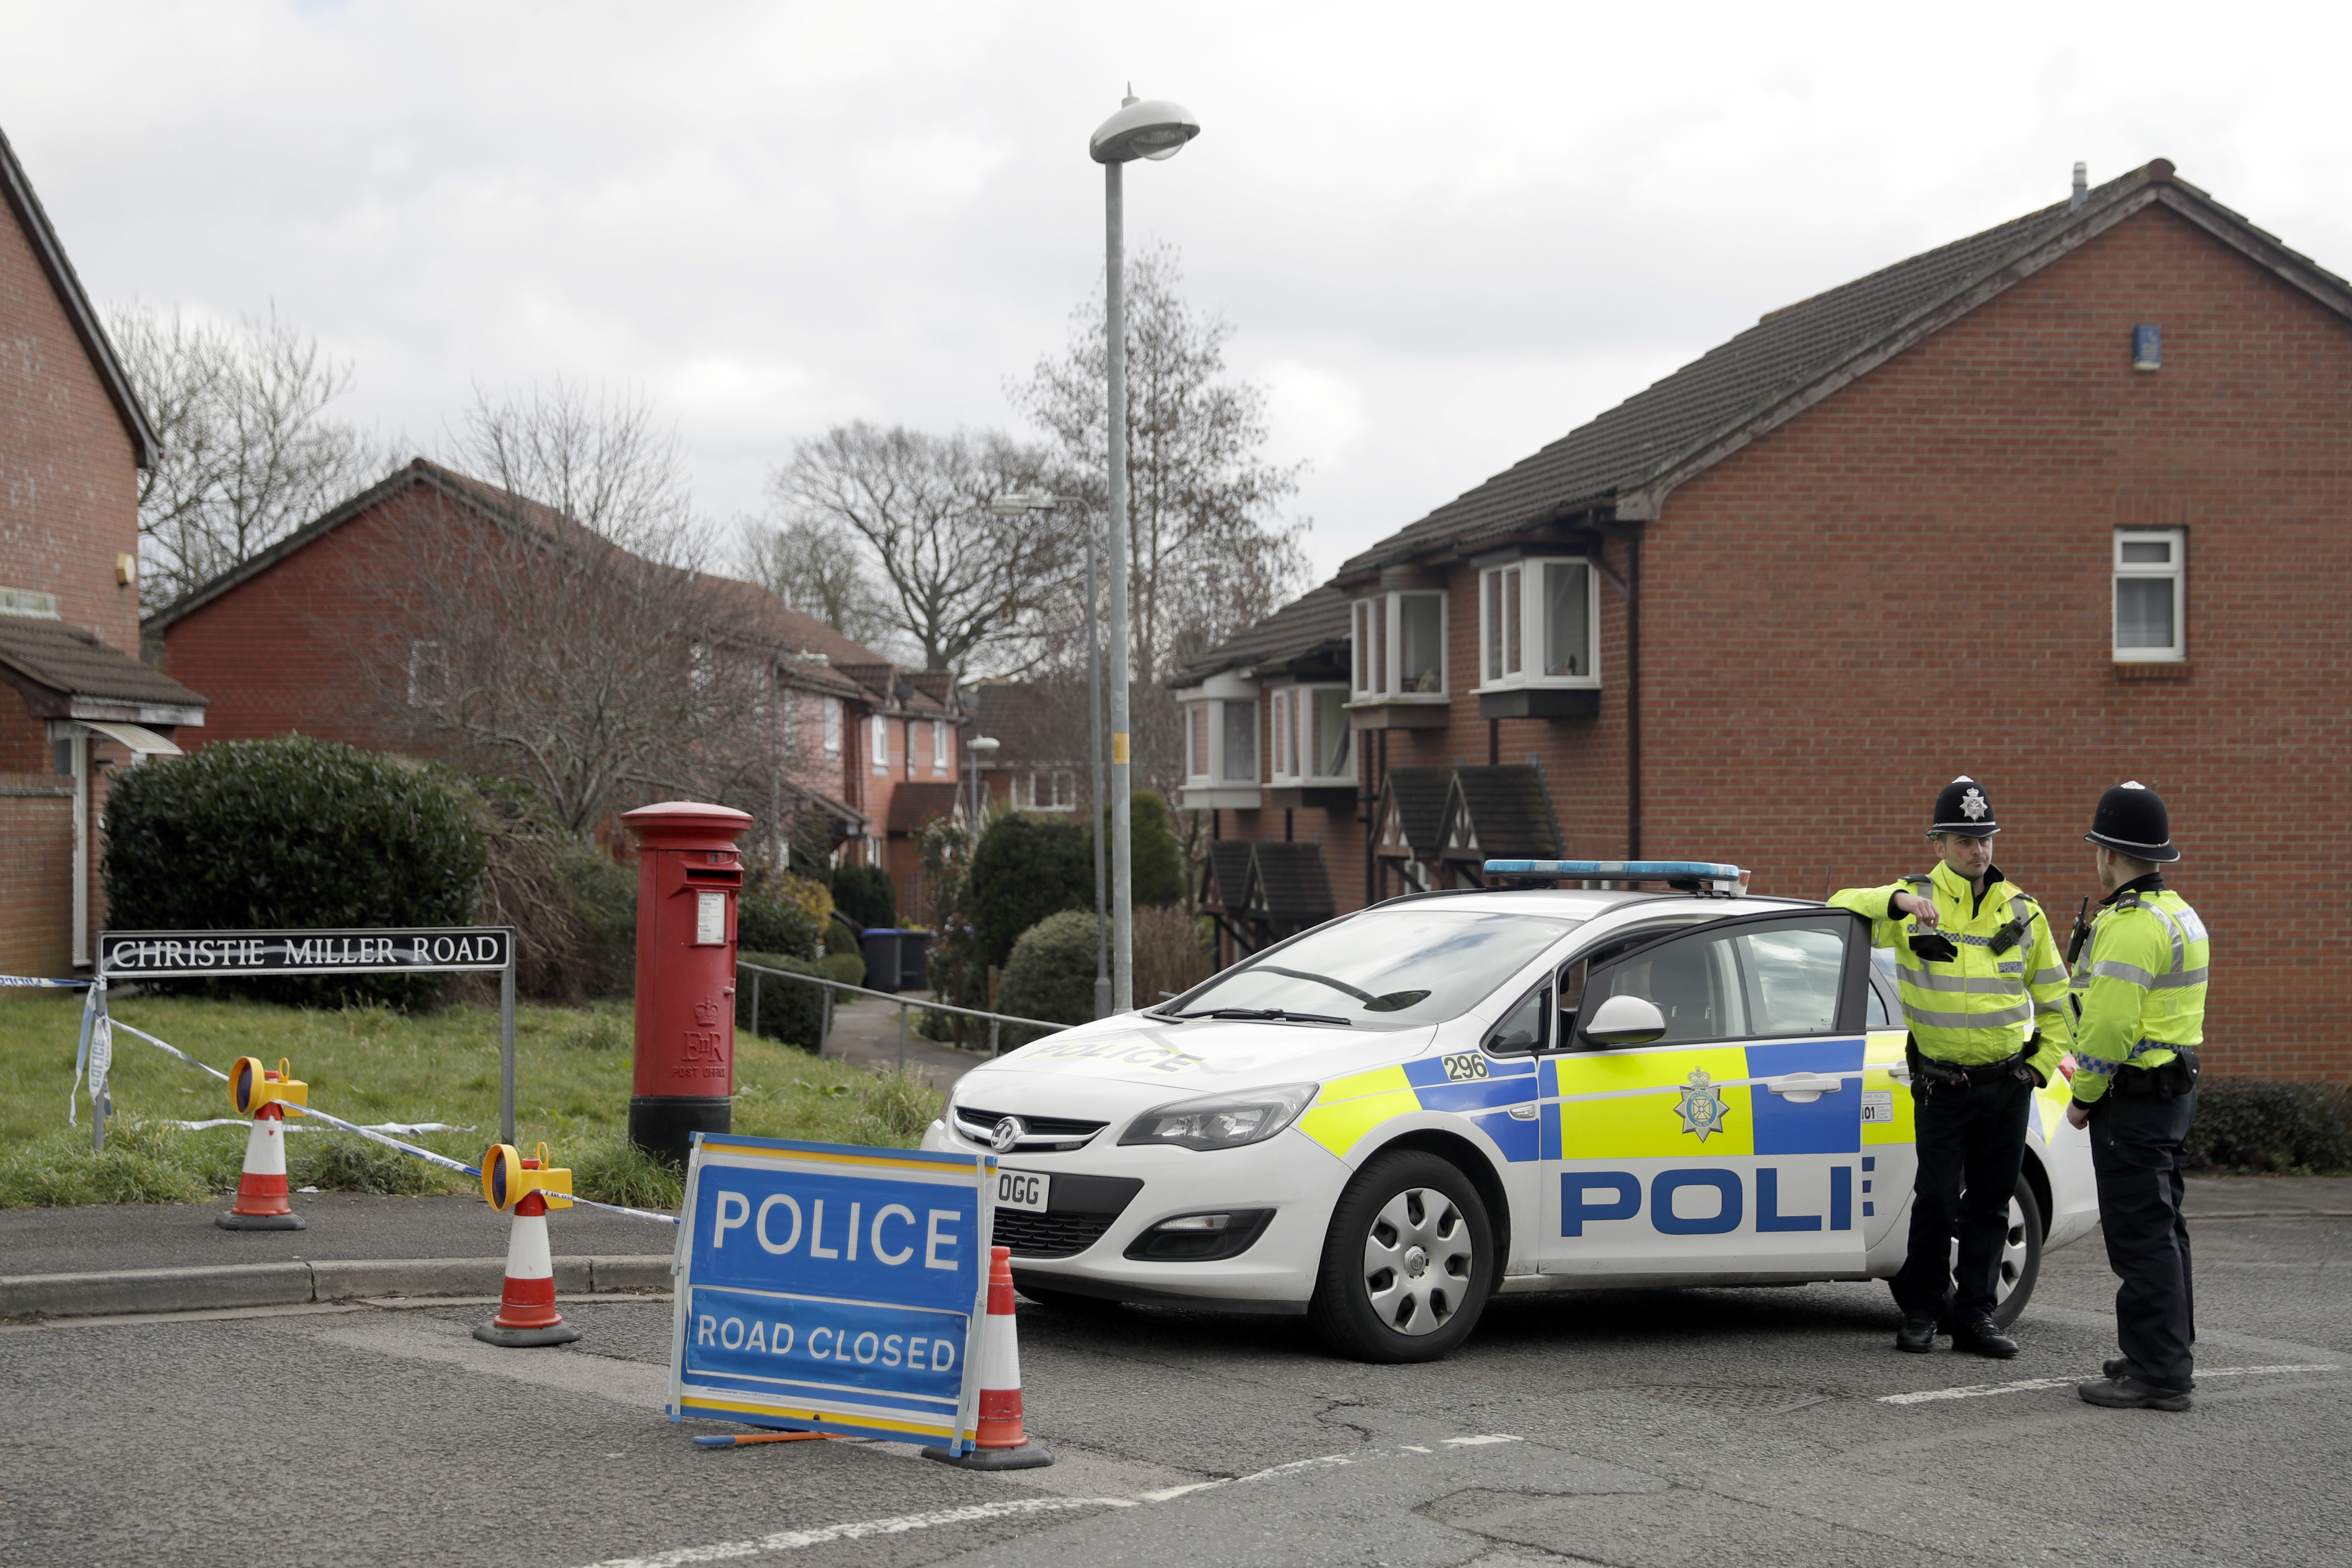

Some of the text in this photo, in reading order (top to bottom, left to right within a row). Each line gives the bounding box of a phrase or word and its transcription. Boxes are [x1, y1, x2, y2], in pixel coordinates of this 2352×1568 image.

[113, 936, 499, 968] CHRISTIE MILLER ROAD
[672, 1066, 699, 1077] POST
[1019, 1044, 1207, 1072] POLICE
[1444, 1054, 1487, 1080] 296
[1690, 1091, 1712, 1100] WILTSHIRE
[999, 1174, 1039, 1204] OGG
[714, 1191, 961, 1271] POLICE
[698, 1315, 955, 1372] ROAD CLOSED
